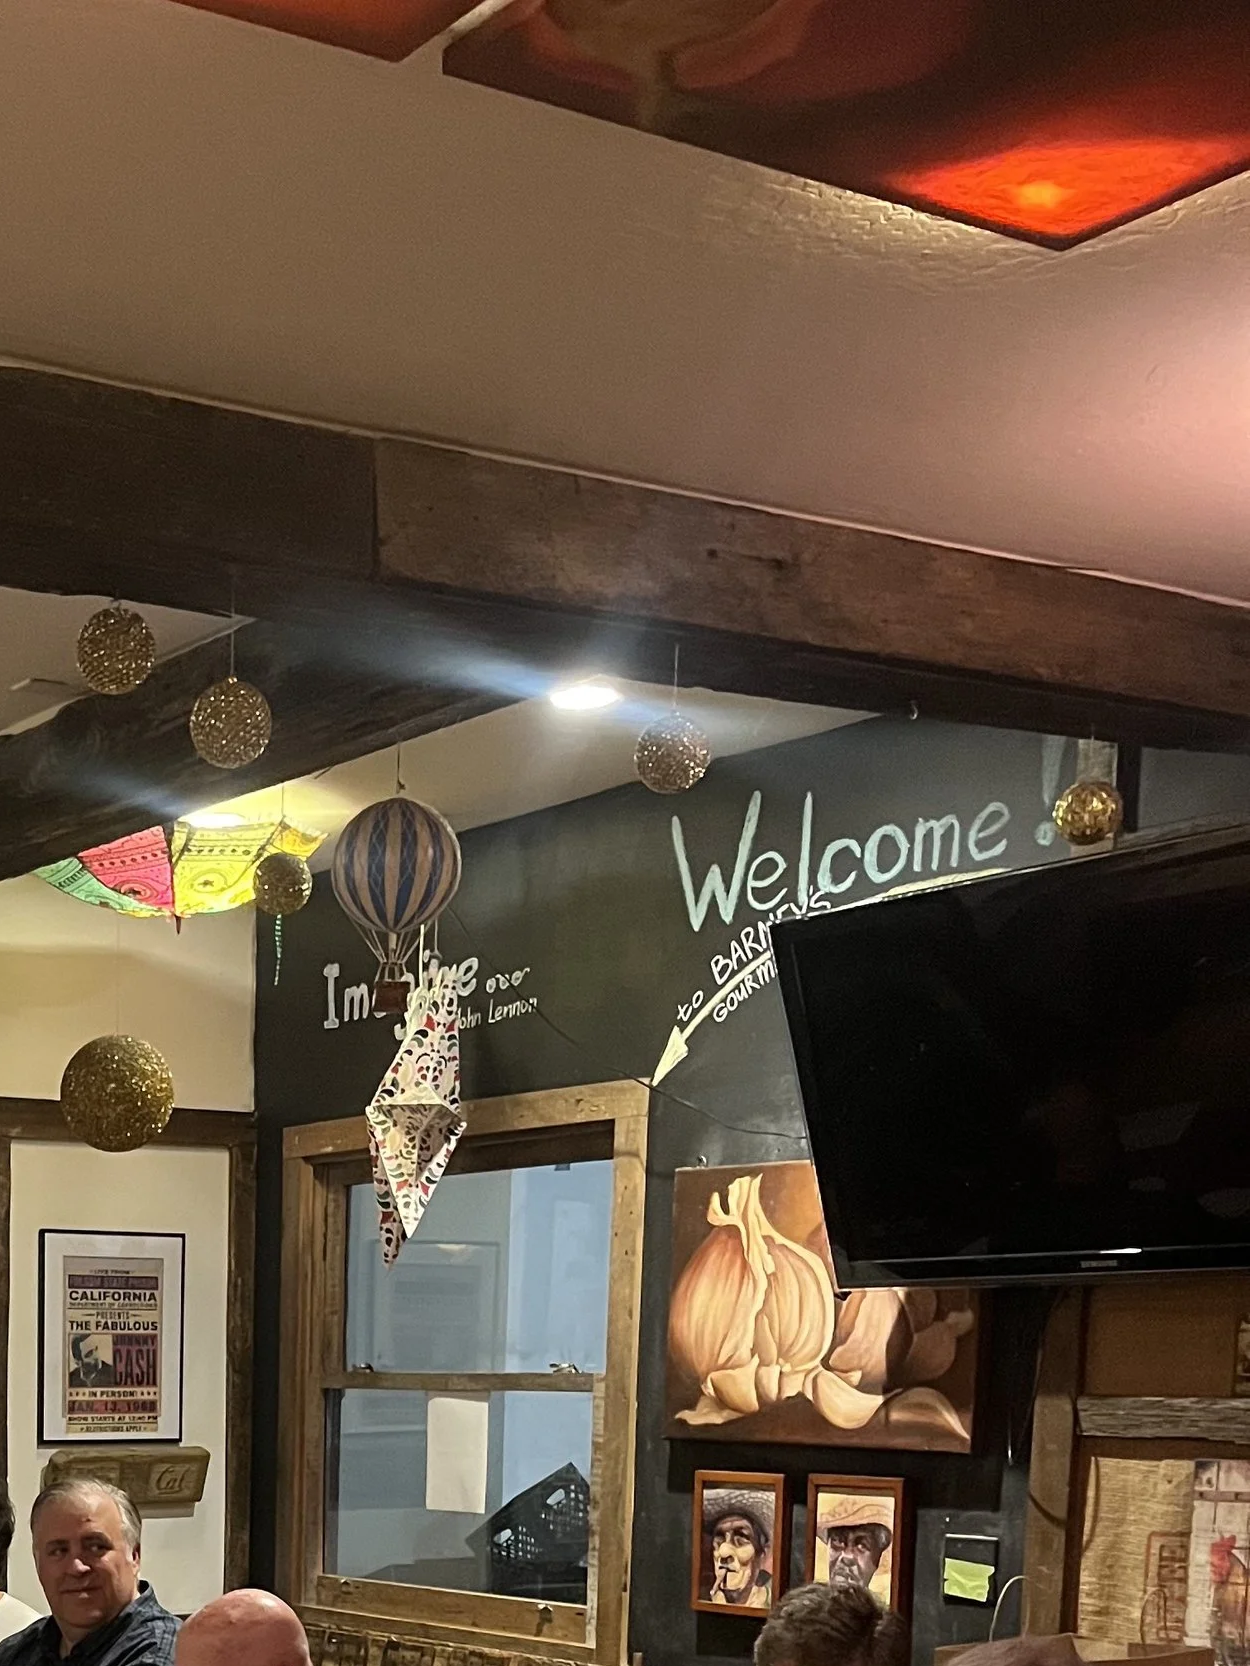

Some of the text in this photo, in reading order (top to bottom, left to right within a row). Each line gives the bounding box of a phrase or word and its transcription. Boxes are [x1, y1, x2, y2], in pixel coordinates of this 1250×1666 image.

[488, 997, 538, 1023] Lennon
[69, 1290, 157, 1302] CALIFORNIA
[69, 1320, 158, 1331] THE FABULOUS
[113, 1348, 157, 1386] CASH
[88, 1390, 98, 1398] IN
[156, 1464, 191, 1495] Cal
